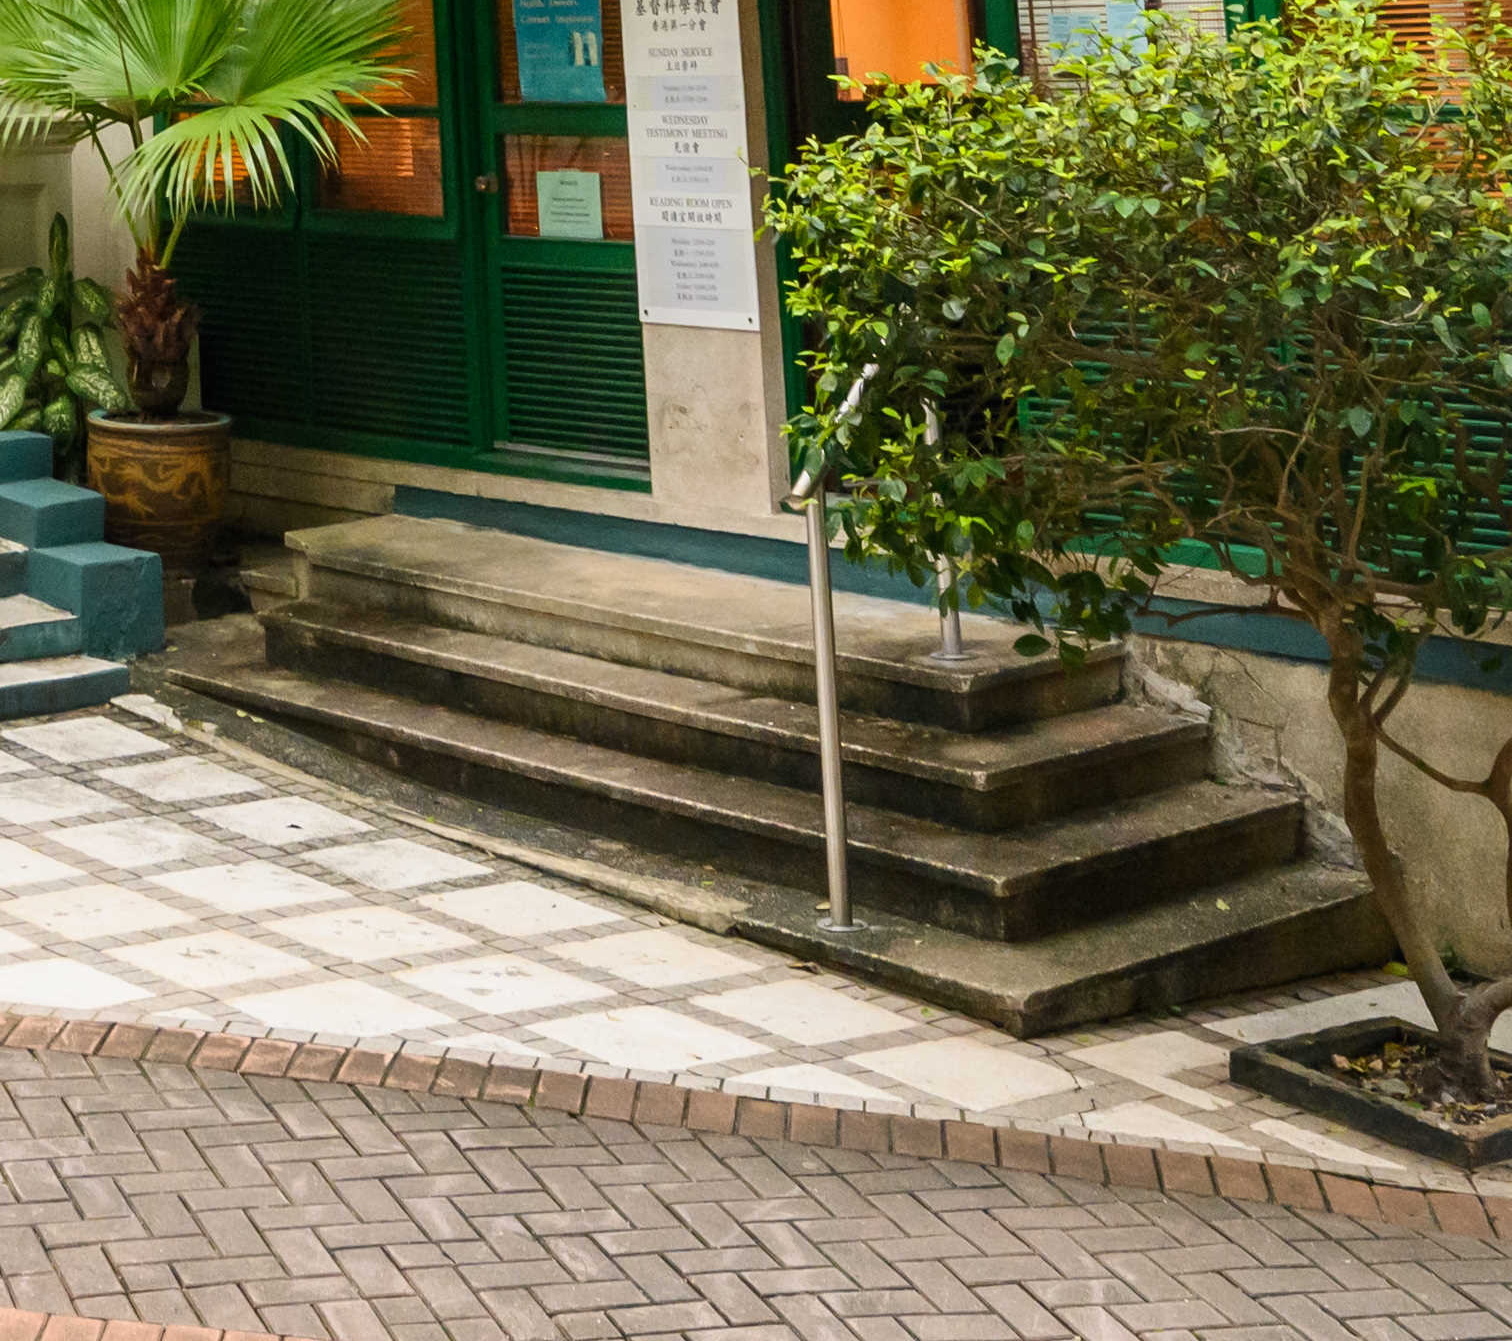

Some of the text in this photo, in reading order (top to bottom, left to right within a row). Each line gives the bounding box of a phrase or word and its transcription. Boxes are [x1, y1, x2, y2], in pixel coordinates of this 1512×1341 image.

[681, 47, 712, 57] SERVICE
[649, 197, 683, 207] READING
[686, 197, 710, 207] ROOM
